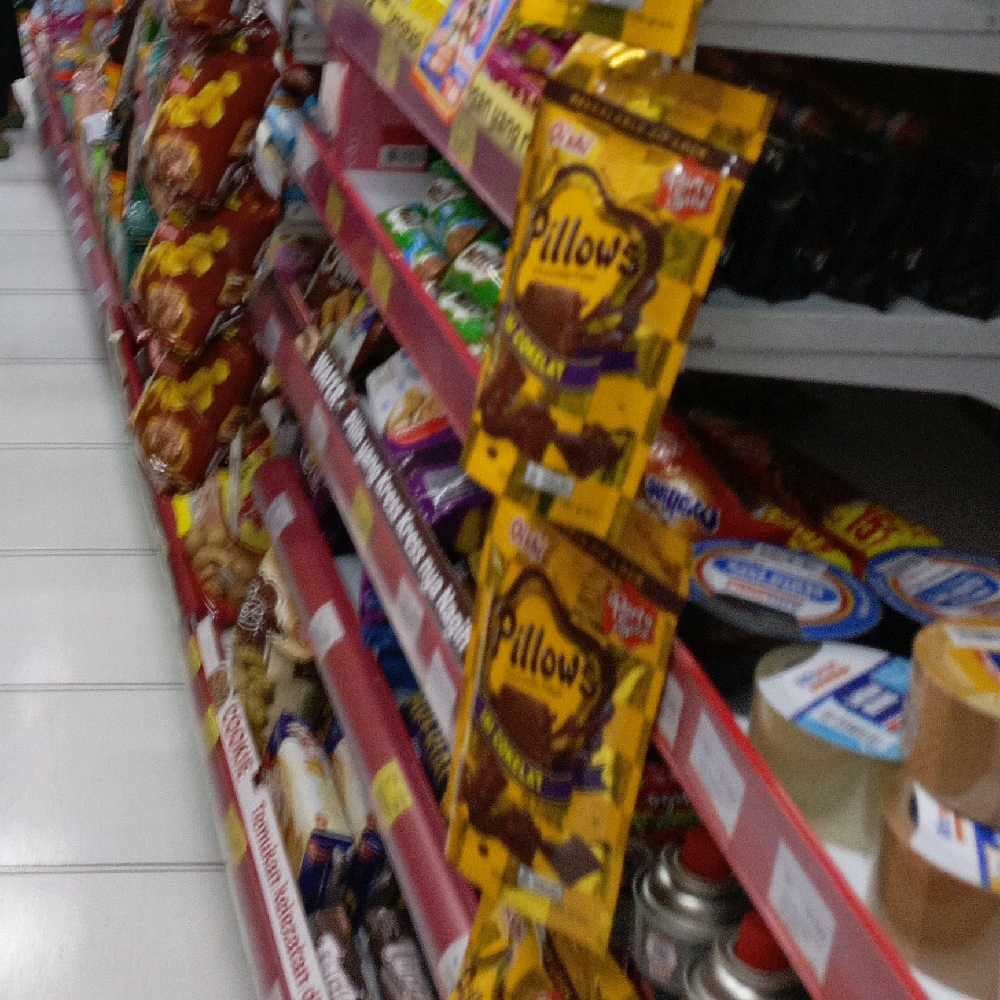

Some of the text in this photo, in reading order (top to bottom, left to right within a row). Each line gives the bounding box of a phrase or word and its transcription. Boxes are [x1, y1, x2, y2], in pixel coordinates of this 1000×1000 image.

[521, 203, 640, 278] Pillows
[371, 472, 408, 522] Kress
[394, 511, 432, 565] Kress
[432, 586, 474, 654] Nagih
[492, 615, 599, 698] Pillows
[221, 702, 256, 779] COOKIE
[251, 801, 311, 984] Temukan kelezatan
